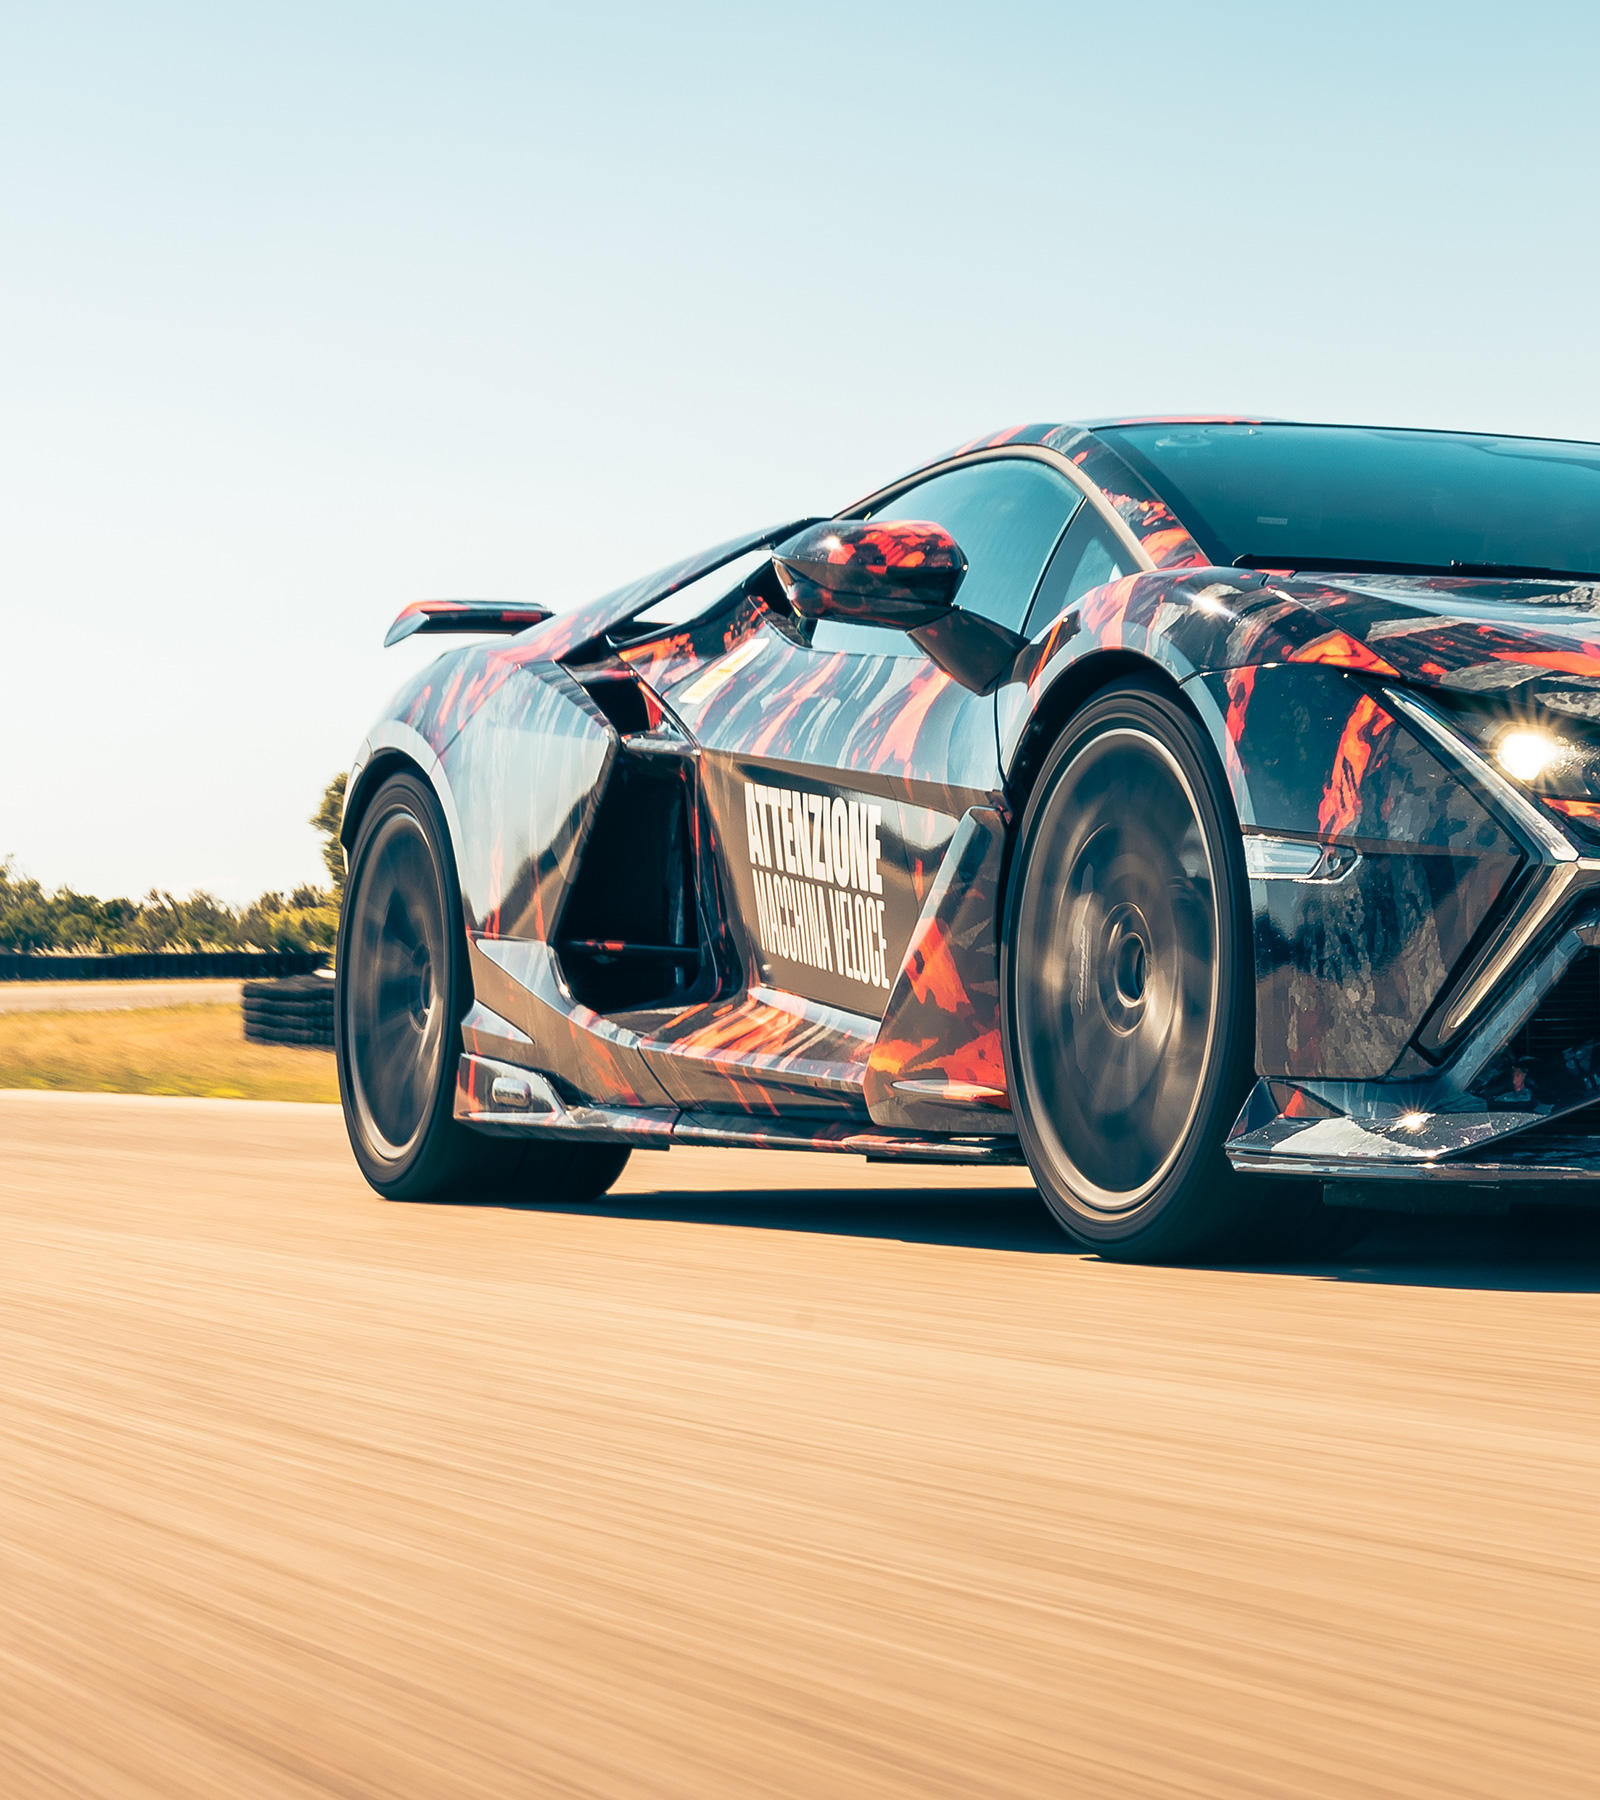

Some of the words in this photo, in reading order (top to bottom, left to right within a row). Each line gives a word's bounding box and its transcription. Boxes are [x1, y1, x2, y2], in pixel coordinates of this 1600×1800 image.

[744, 781, 883, 895] ATTENZIONE
[752, 868, 833, 973] MACCHINA
[828, 887, 890, 990] VELOCE
